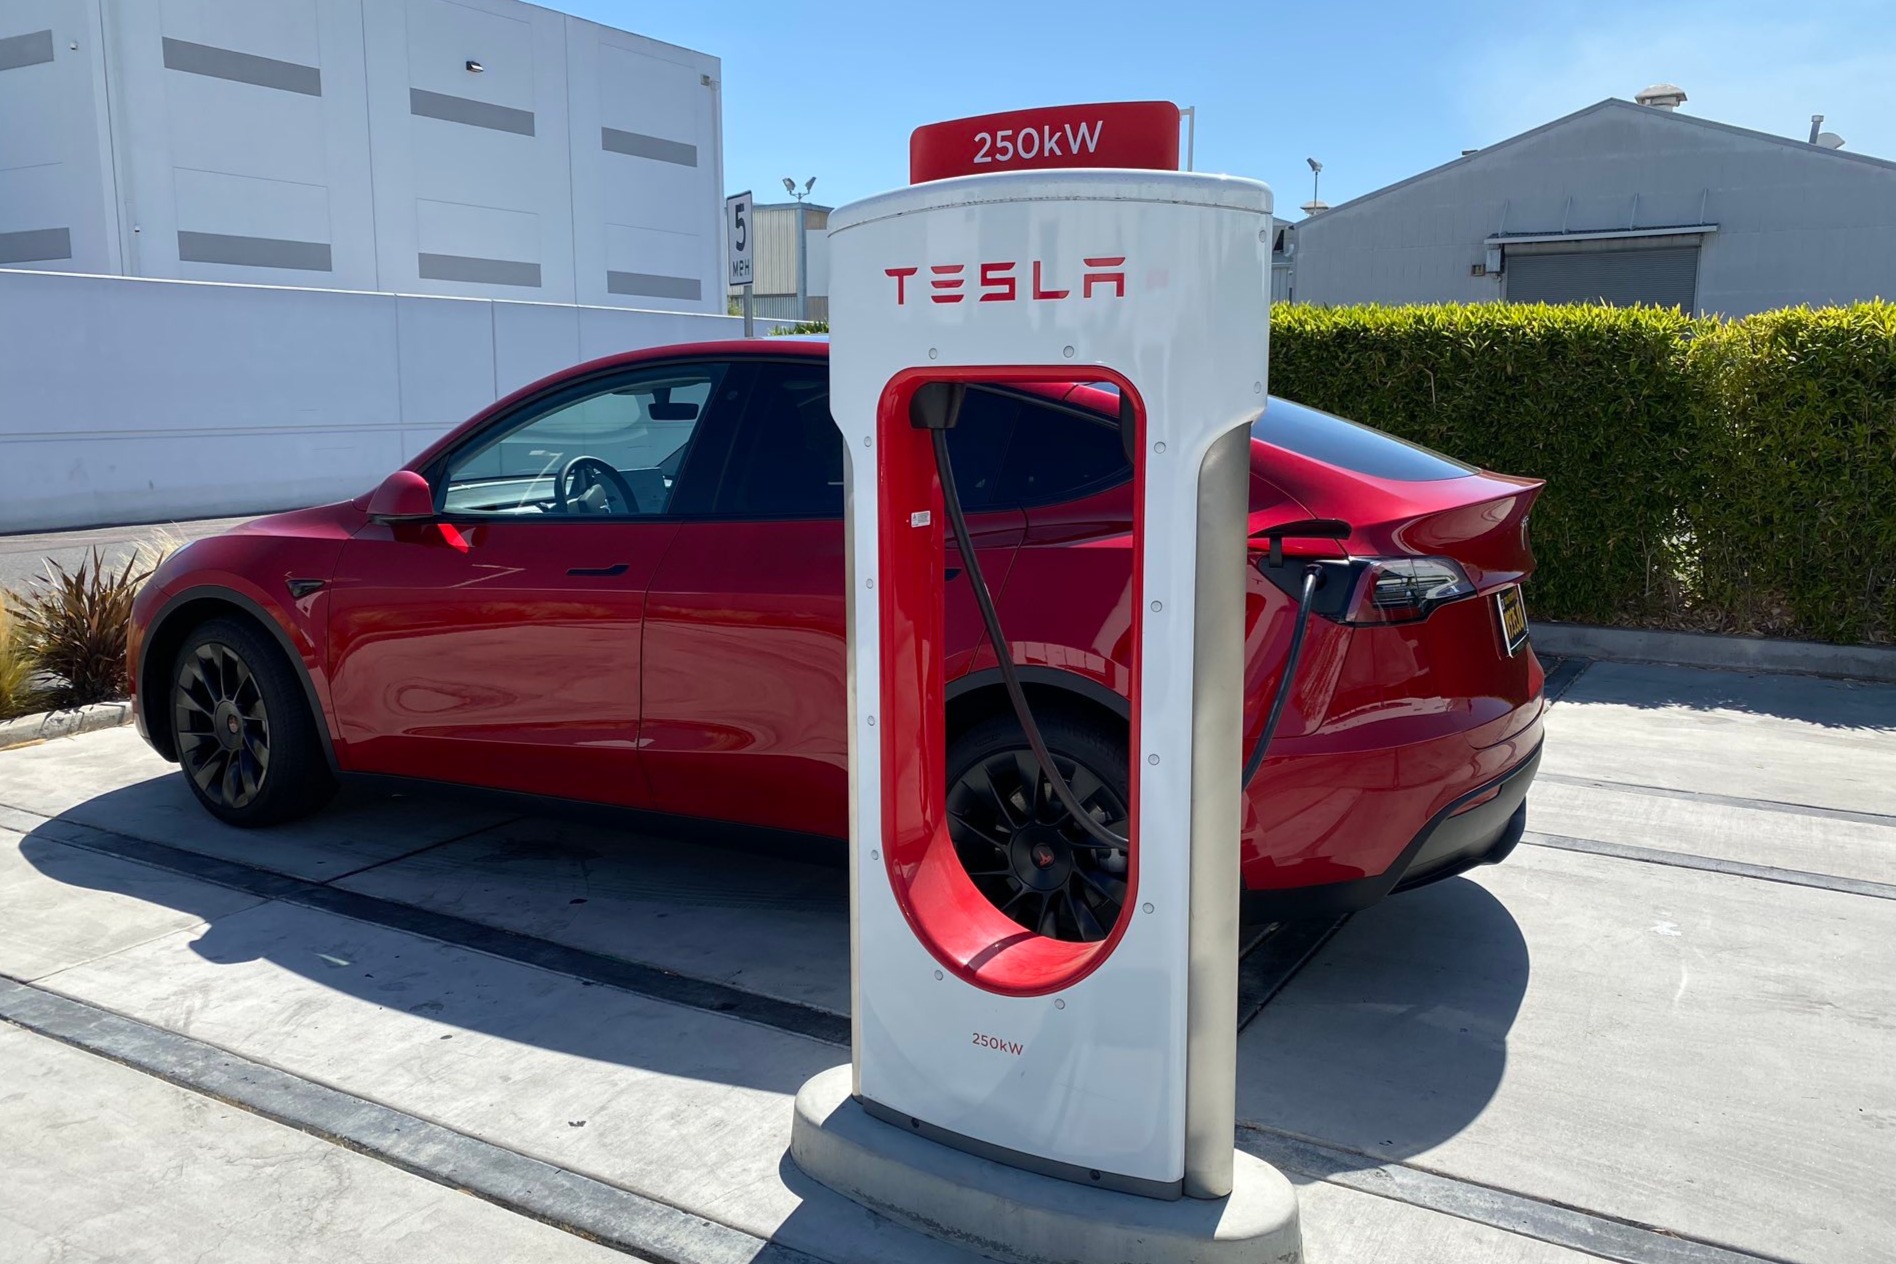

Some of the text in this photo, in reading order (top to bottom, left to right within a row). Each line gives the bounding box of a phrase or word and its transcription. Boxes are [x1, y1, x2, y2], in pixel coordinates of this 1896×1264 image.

[973, 120, 1103, 164] 250kW
[735, 203, 746, 251] 5
[732, 258, 750, 277] MPH
[884, 256, 1126, 305] TESLA
[972, 1032, 1024, 1056] 250kW
